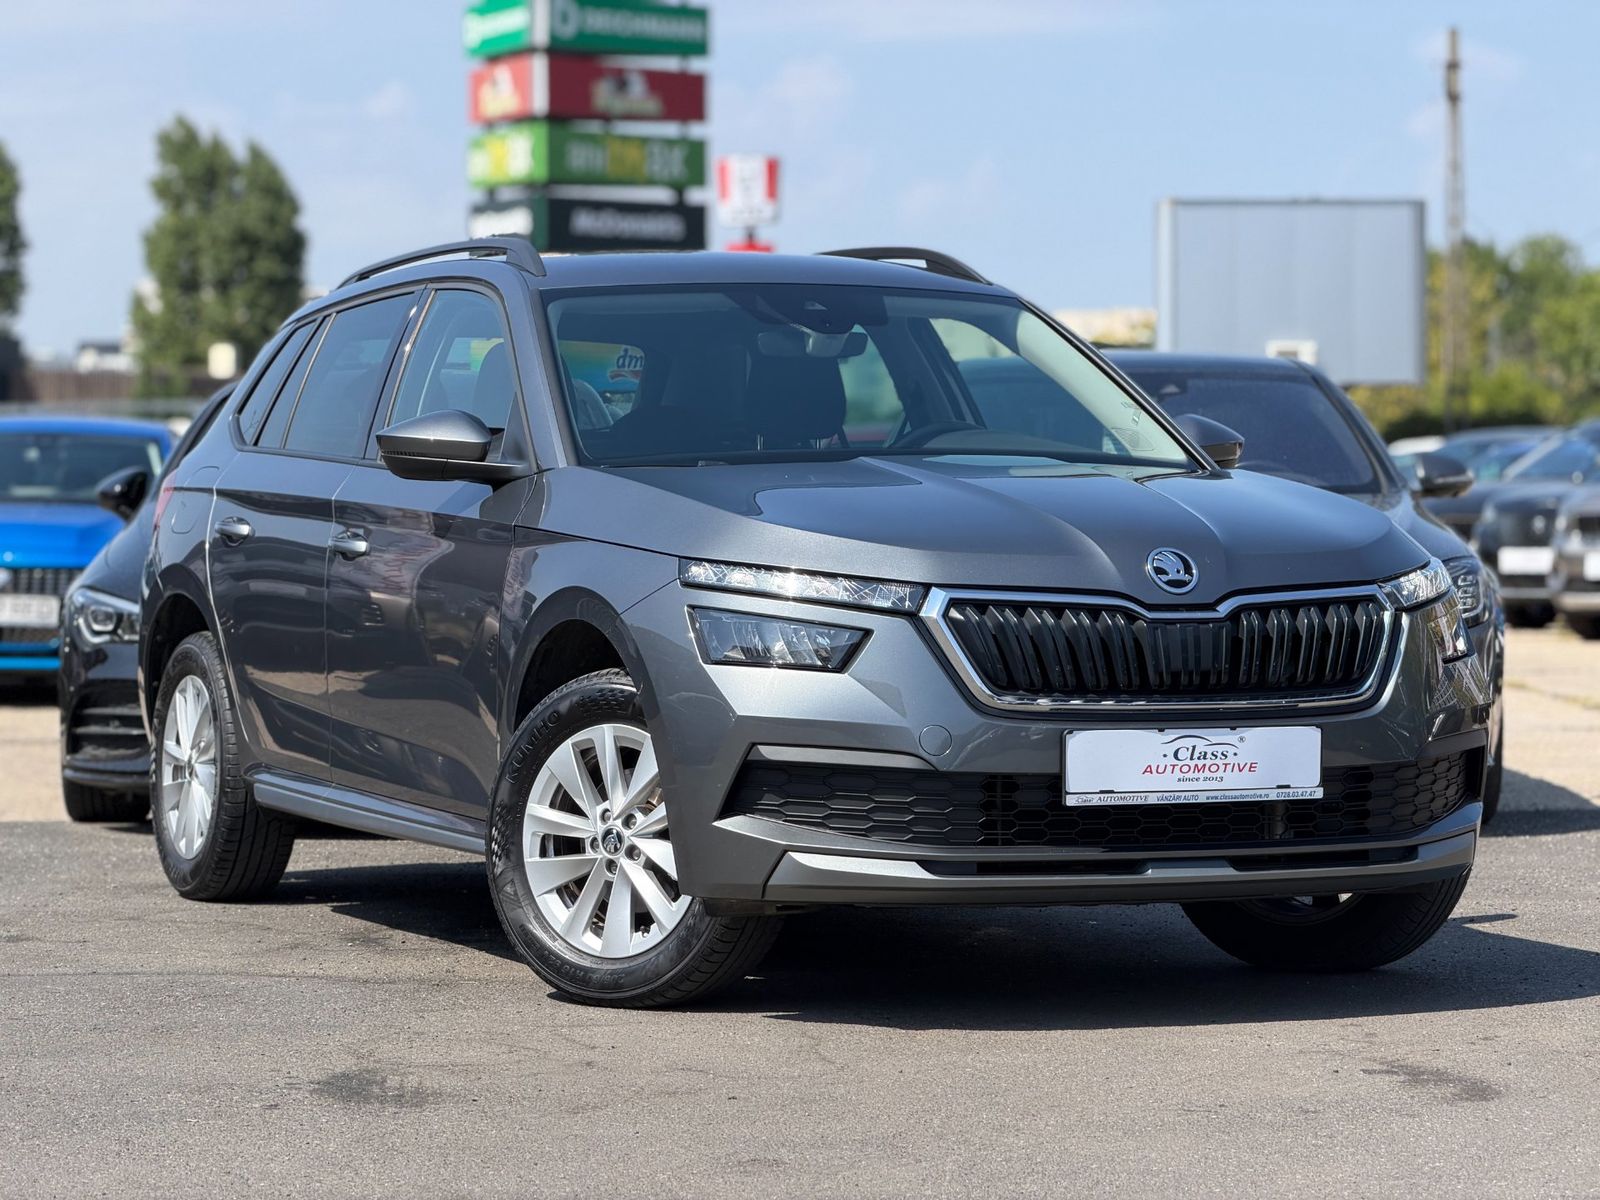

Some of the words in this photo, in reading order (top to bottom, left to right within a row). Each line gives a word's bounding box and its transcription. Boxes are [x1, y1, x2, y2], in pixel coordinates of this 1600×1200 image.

[616, 348, 644, 370] dm
[1173, 745, 1229, 761] Class
[1142, 762, 1258, 775] AUTOMOTIVE
[1177, 775, 1201, 783] since
[1097, 795, 1149, 803] AUTOMOTIVE
[1183, 794, 1199, 802] AUTO
[1276, 791, 1317, 799] 0728.03.47.47
